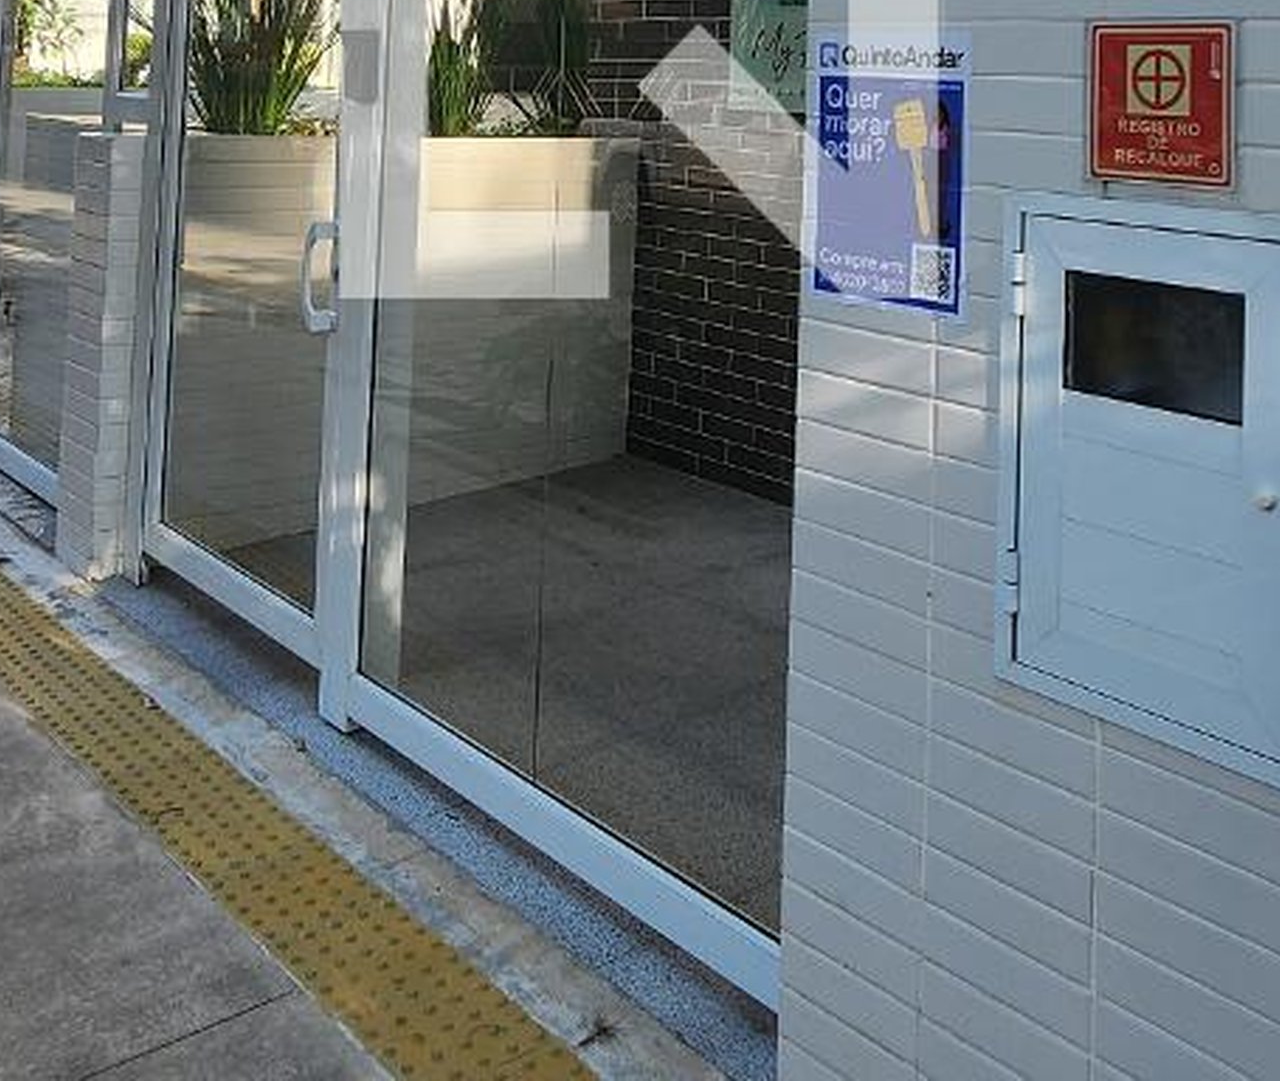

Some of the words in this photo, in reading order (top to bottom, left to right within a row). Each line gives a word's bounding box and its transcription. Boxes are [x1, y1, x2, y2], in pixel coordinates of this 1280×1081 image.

[841, 44, 965, 69] QuintoAndar
[825, 83, 883, 111] Quer
[824, 115, 892, 136] morar
[1117, 116, 1202, 137] REGISTRO
[824, 135, 886, 166] aqui?
[1146, 135, 1170, 150] DE
[1114, 148, 1204, 168] RECALQUE
